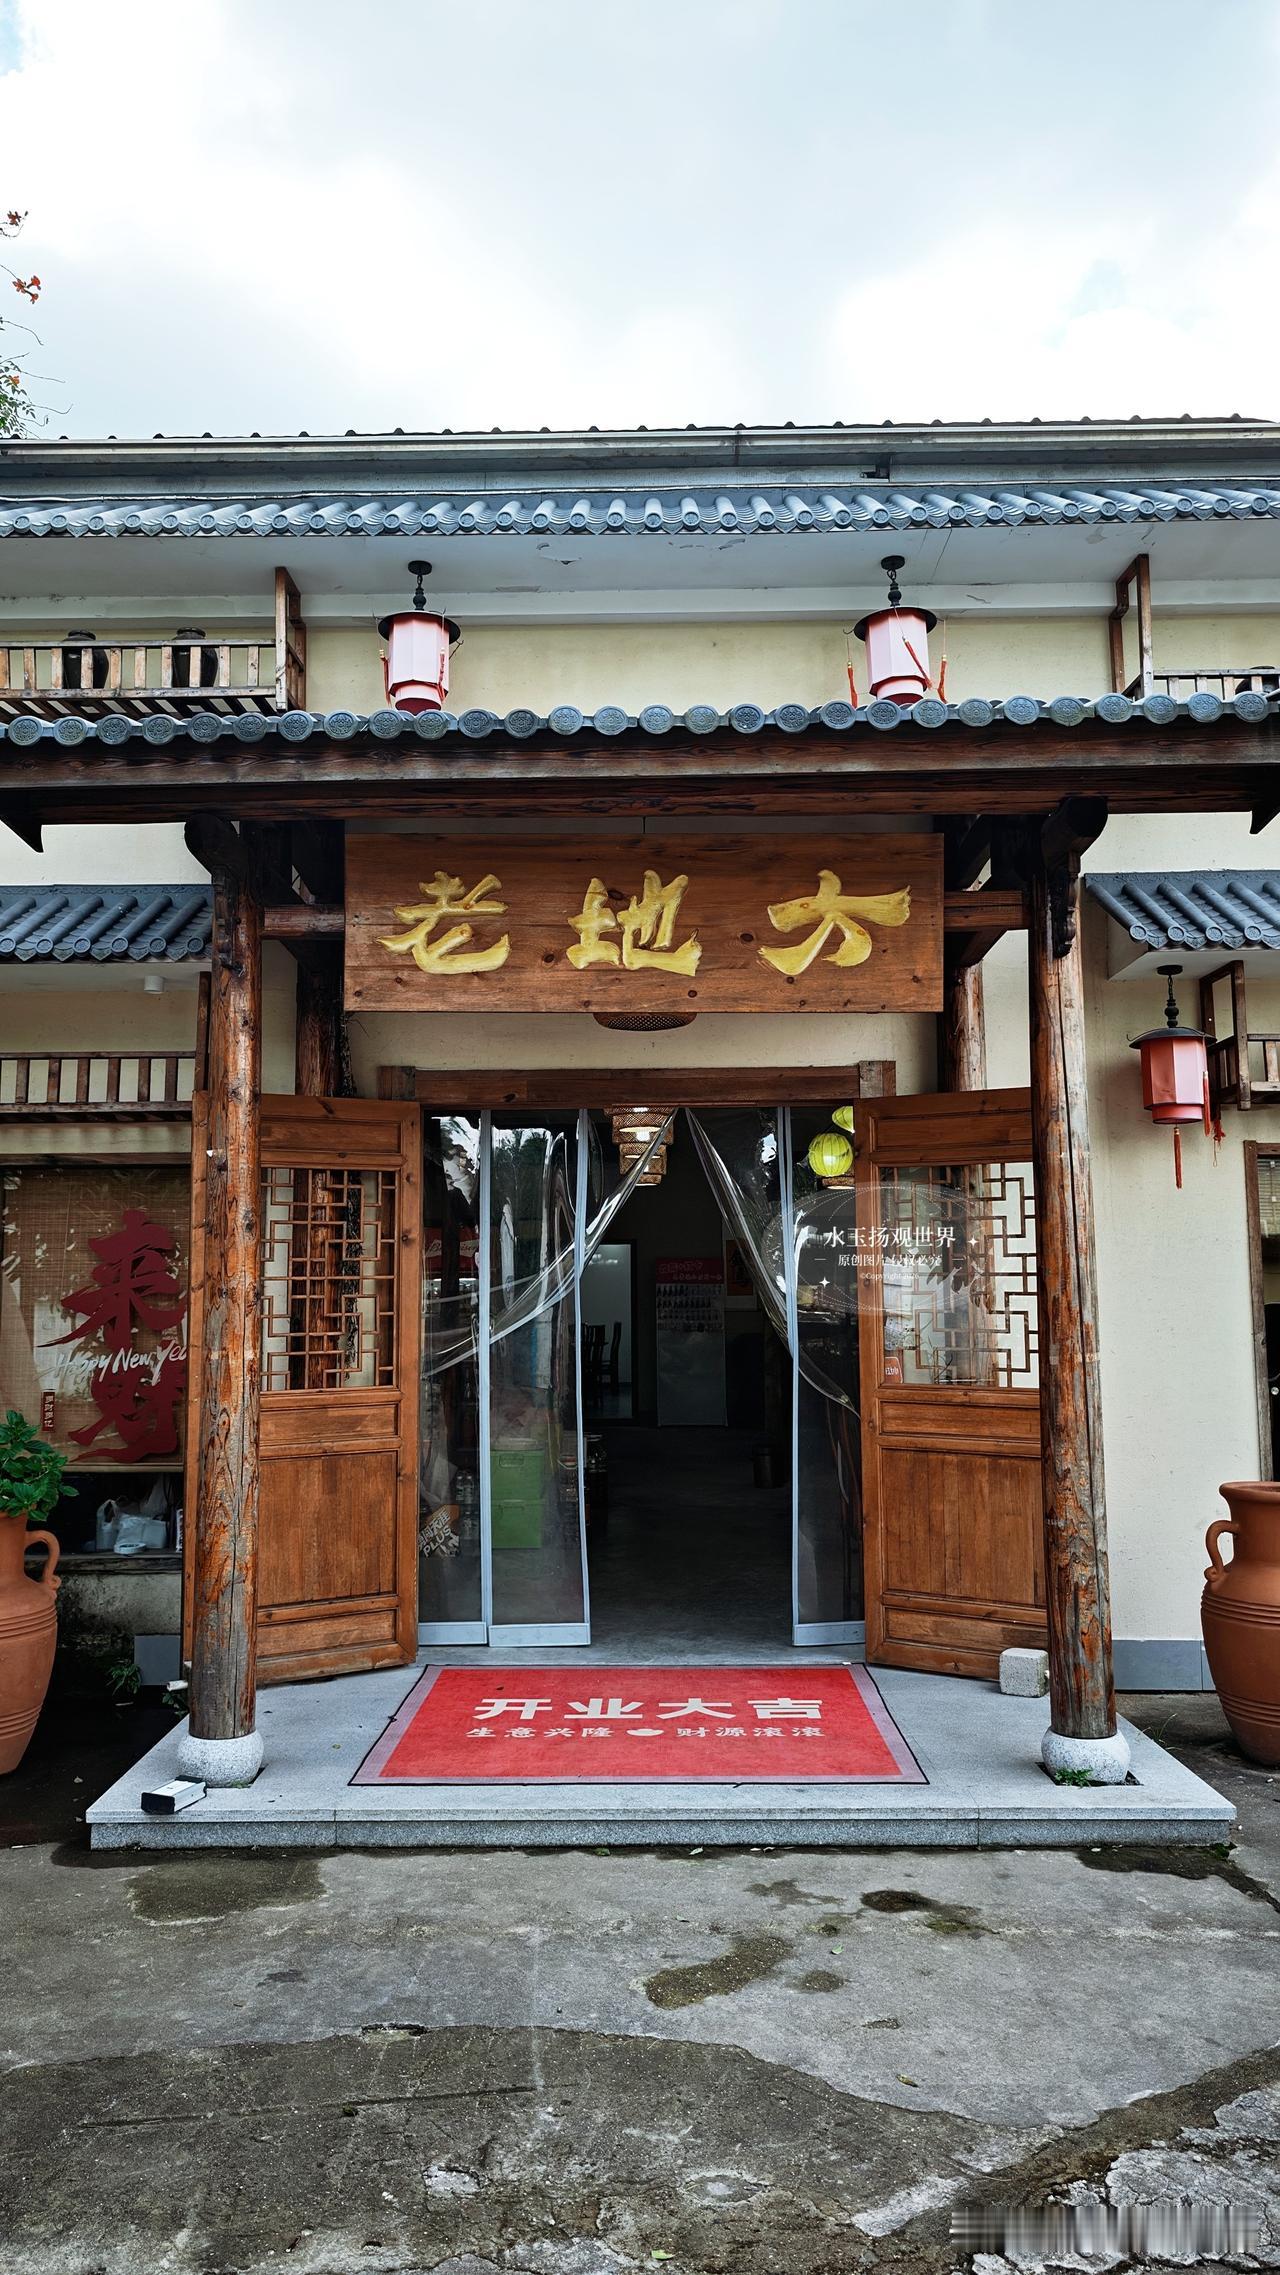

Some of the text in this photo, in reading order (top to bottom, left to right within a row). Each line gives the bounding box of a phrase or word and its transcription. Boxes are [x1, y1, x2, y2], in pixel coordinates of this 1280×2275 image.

[374, 869, 911, 976] 老地方
[54, 1339, 188, 1386] Happy New Yea
[423, 1524, 452, 1557] PLUS
[472, 1698, 822, 1720] 开业大吉
[465, 1727, 826, 1738] 生意兴隆 财源滚滚
